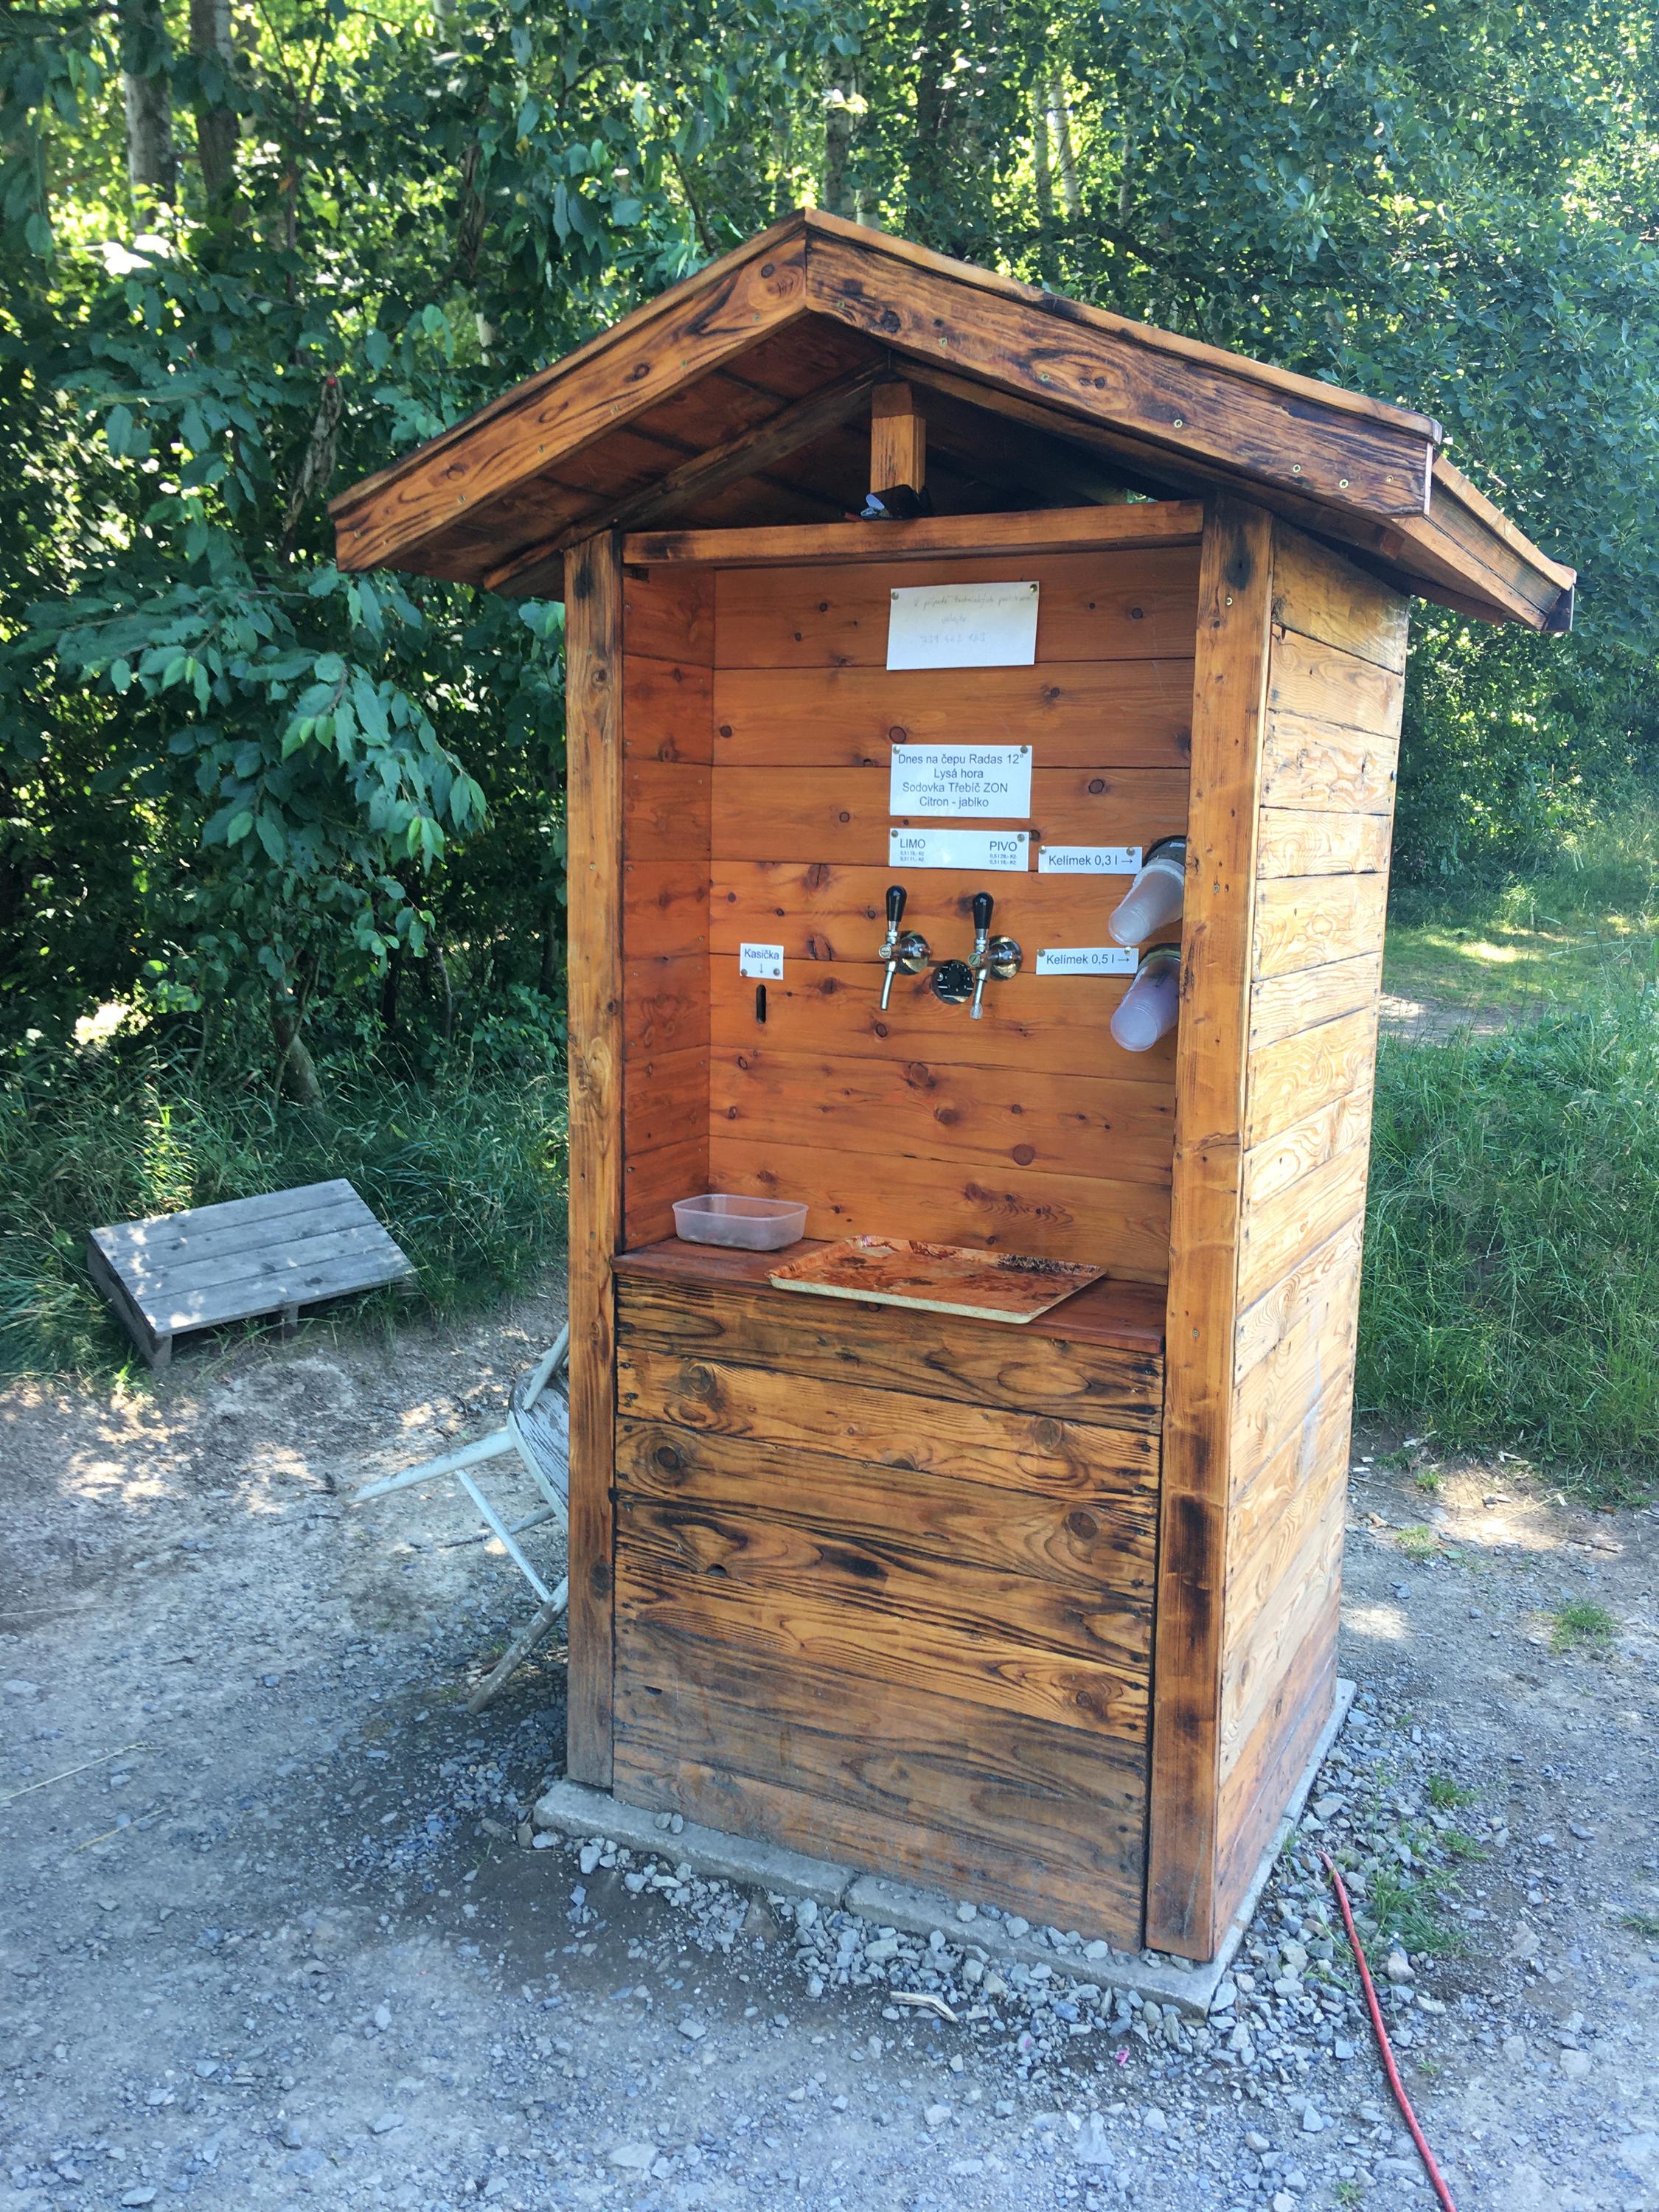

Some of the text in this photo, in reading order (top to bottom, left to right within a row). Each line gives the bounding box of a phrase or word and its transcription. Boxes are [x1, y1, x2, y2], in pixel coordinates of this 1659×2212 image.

[898, 754, 1023, 766] Dnes na čepu Radas 12°
[933, 768, 984, 780] Lysá hora
[902, 782, 1009, 793] Sodovka Třebíč ZON
[919, 796, 949, 807] Citron
[959, 796, 990, 809] jablko
[900, 838, 926, 849] LIMO
[990, 841, 1018, 852] PIVO
[1048, 855, 1091, 866] Kelímek
[1094, 855, 1111, 867] 0,3
[745, 948, 779, 960] Kasička
[1046, 954, 1088, 965] Kelímek
[1091, 953, 1109, 966] 0,5
